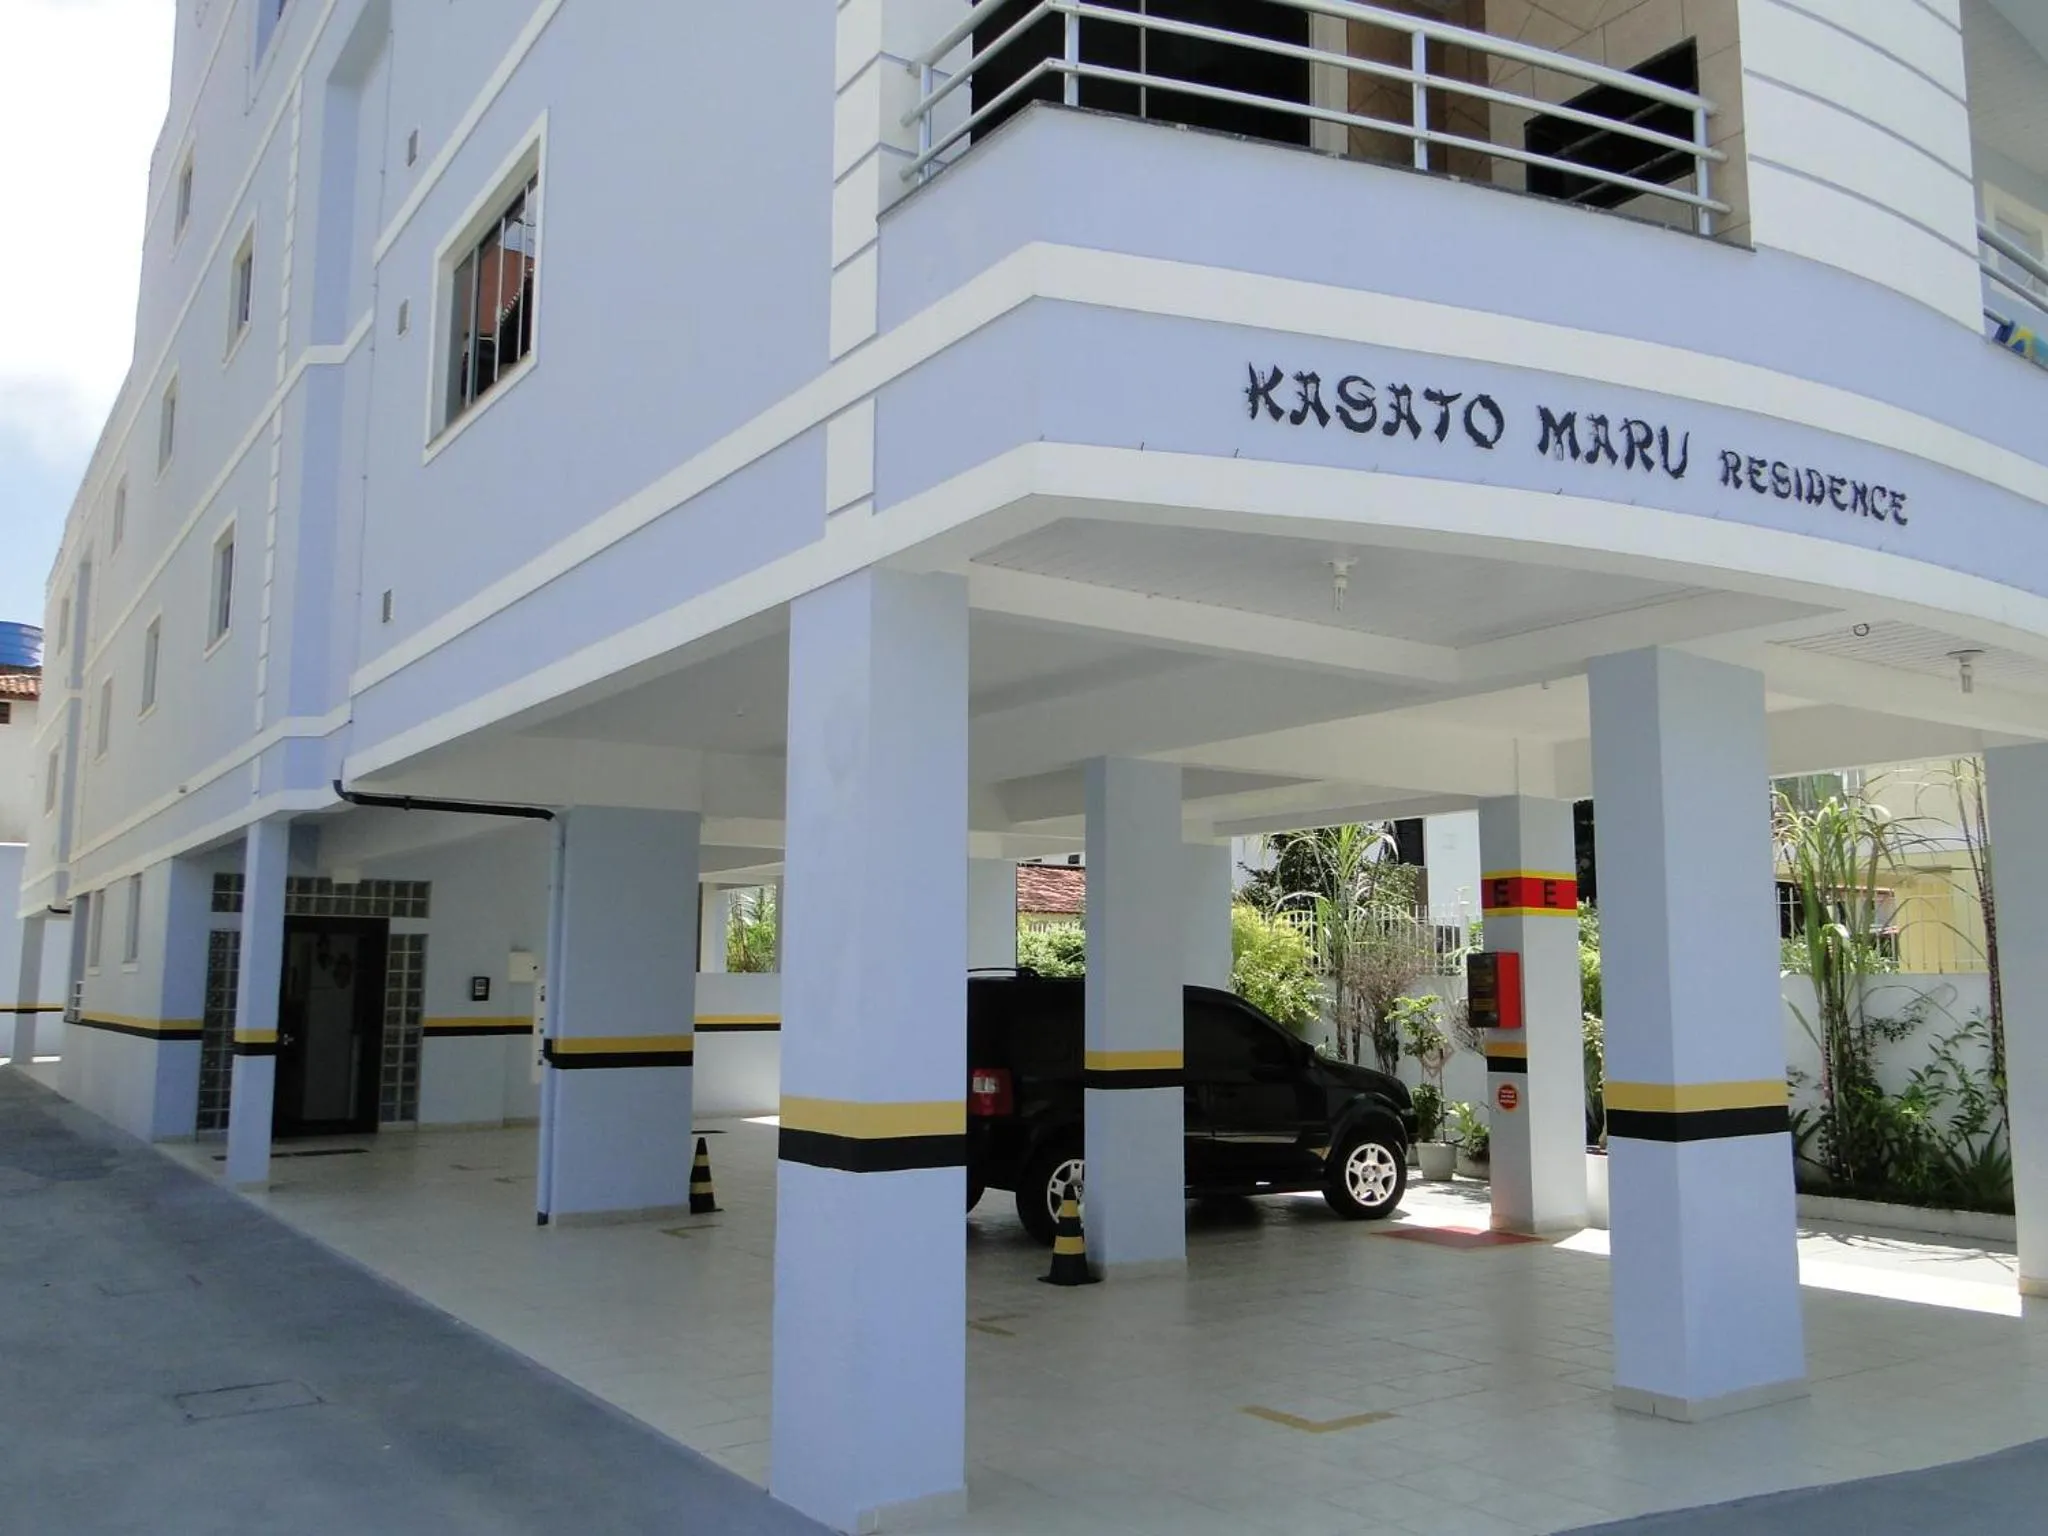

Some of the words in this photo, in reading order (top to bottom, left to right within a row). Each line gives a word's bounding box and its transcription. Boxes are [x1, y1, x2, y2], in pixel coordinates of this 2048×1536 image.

[1243, 362, 1505, 450] KASATO
[1536, 404, 1690, 480] MARU
[1718, 449, 1908, 527] RESIDENCE
[1493, 879, 1509, 907] E
[1543, 880, 1558, 907] E
